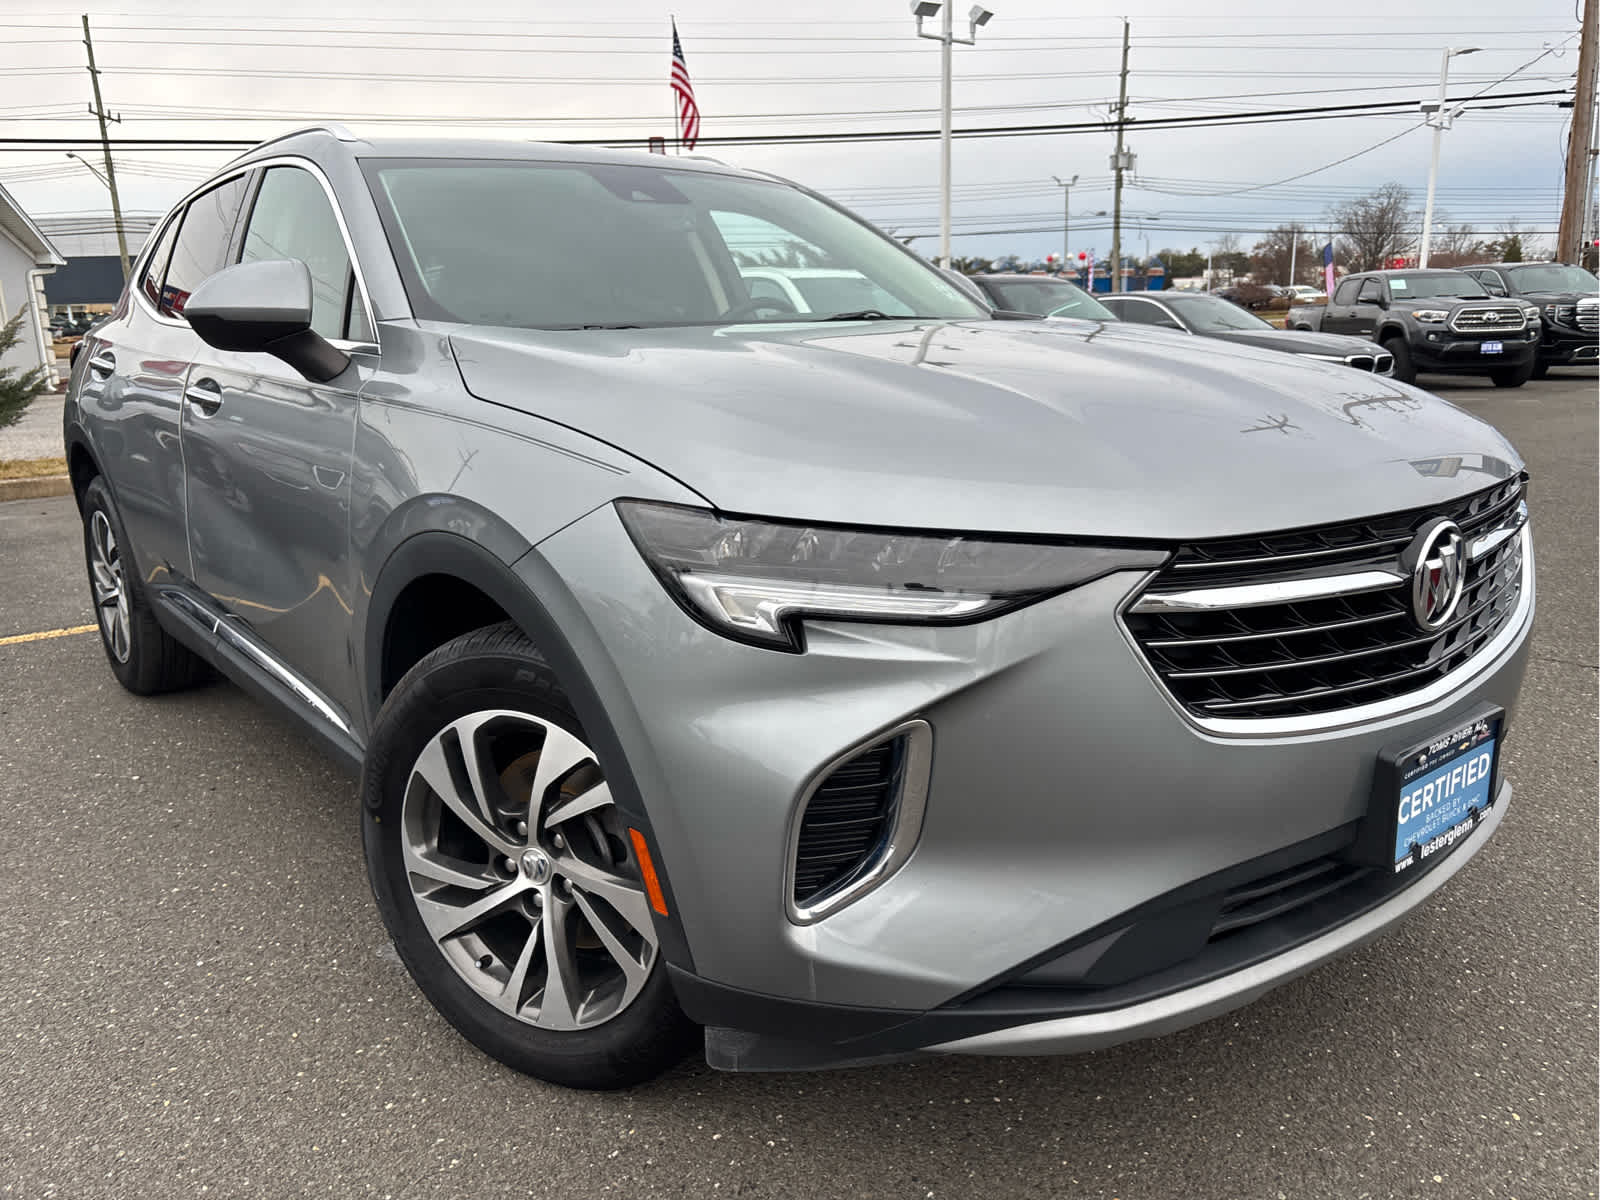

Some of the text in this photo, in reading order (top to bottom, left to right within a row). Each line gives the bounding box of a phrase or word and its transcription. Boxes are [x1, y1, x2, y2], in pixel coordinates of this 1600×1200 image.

[1398, 752, 1490, 825] CERTIFIED
[1403, 816, 1441, 848] CHEVROLET
[1441, 807, 1461, 824] BUICK
[1425, 797, 1461, 824] BACKED BY
[1420, 818, 1473, 859] lesterglenn
